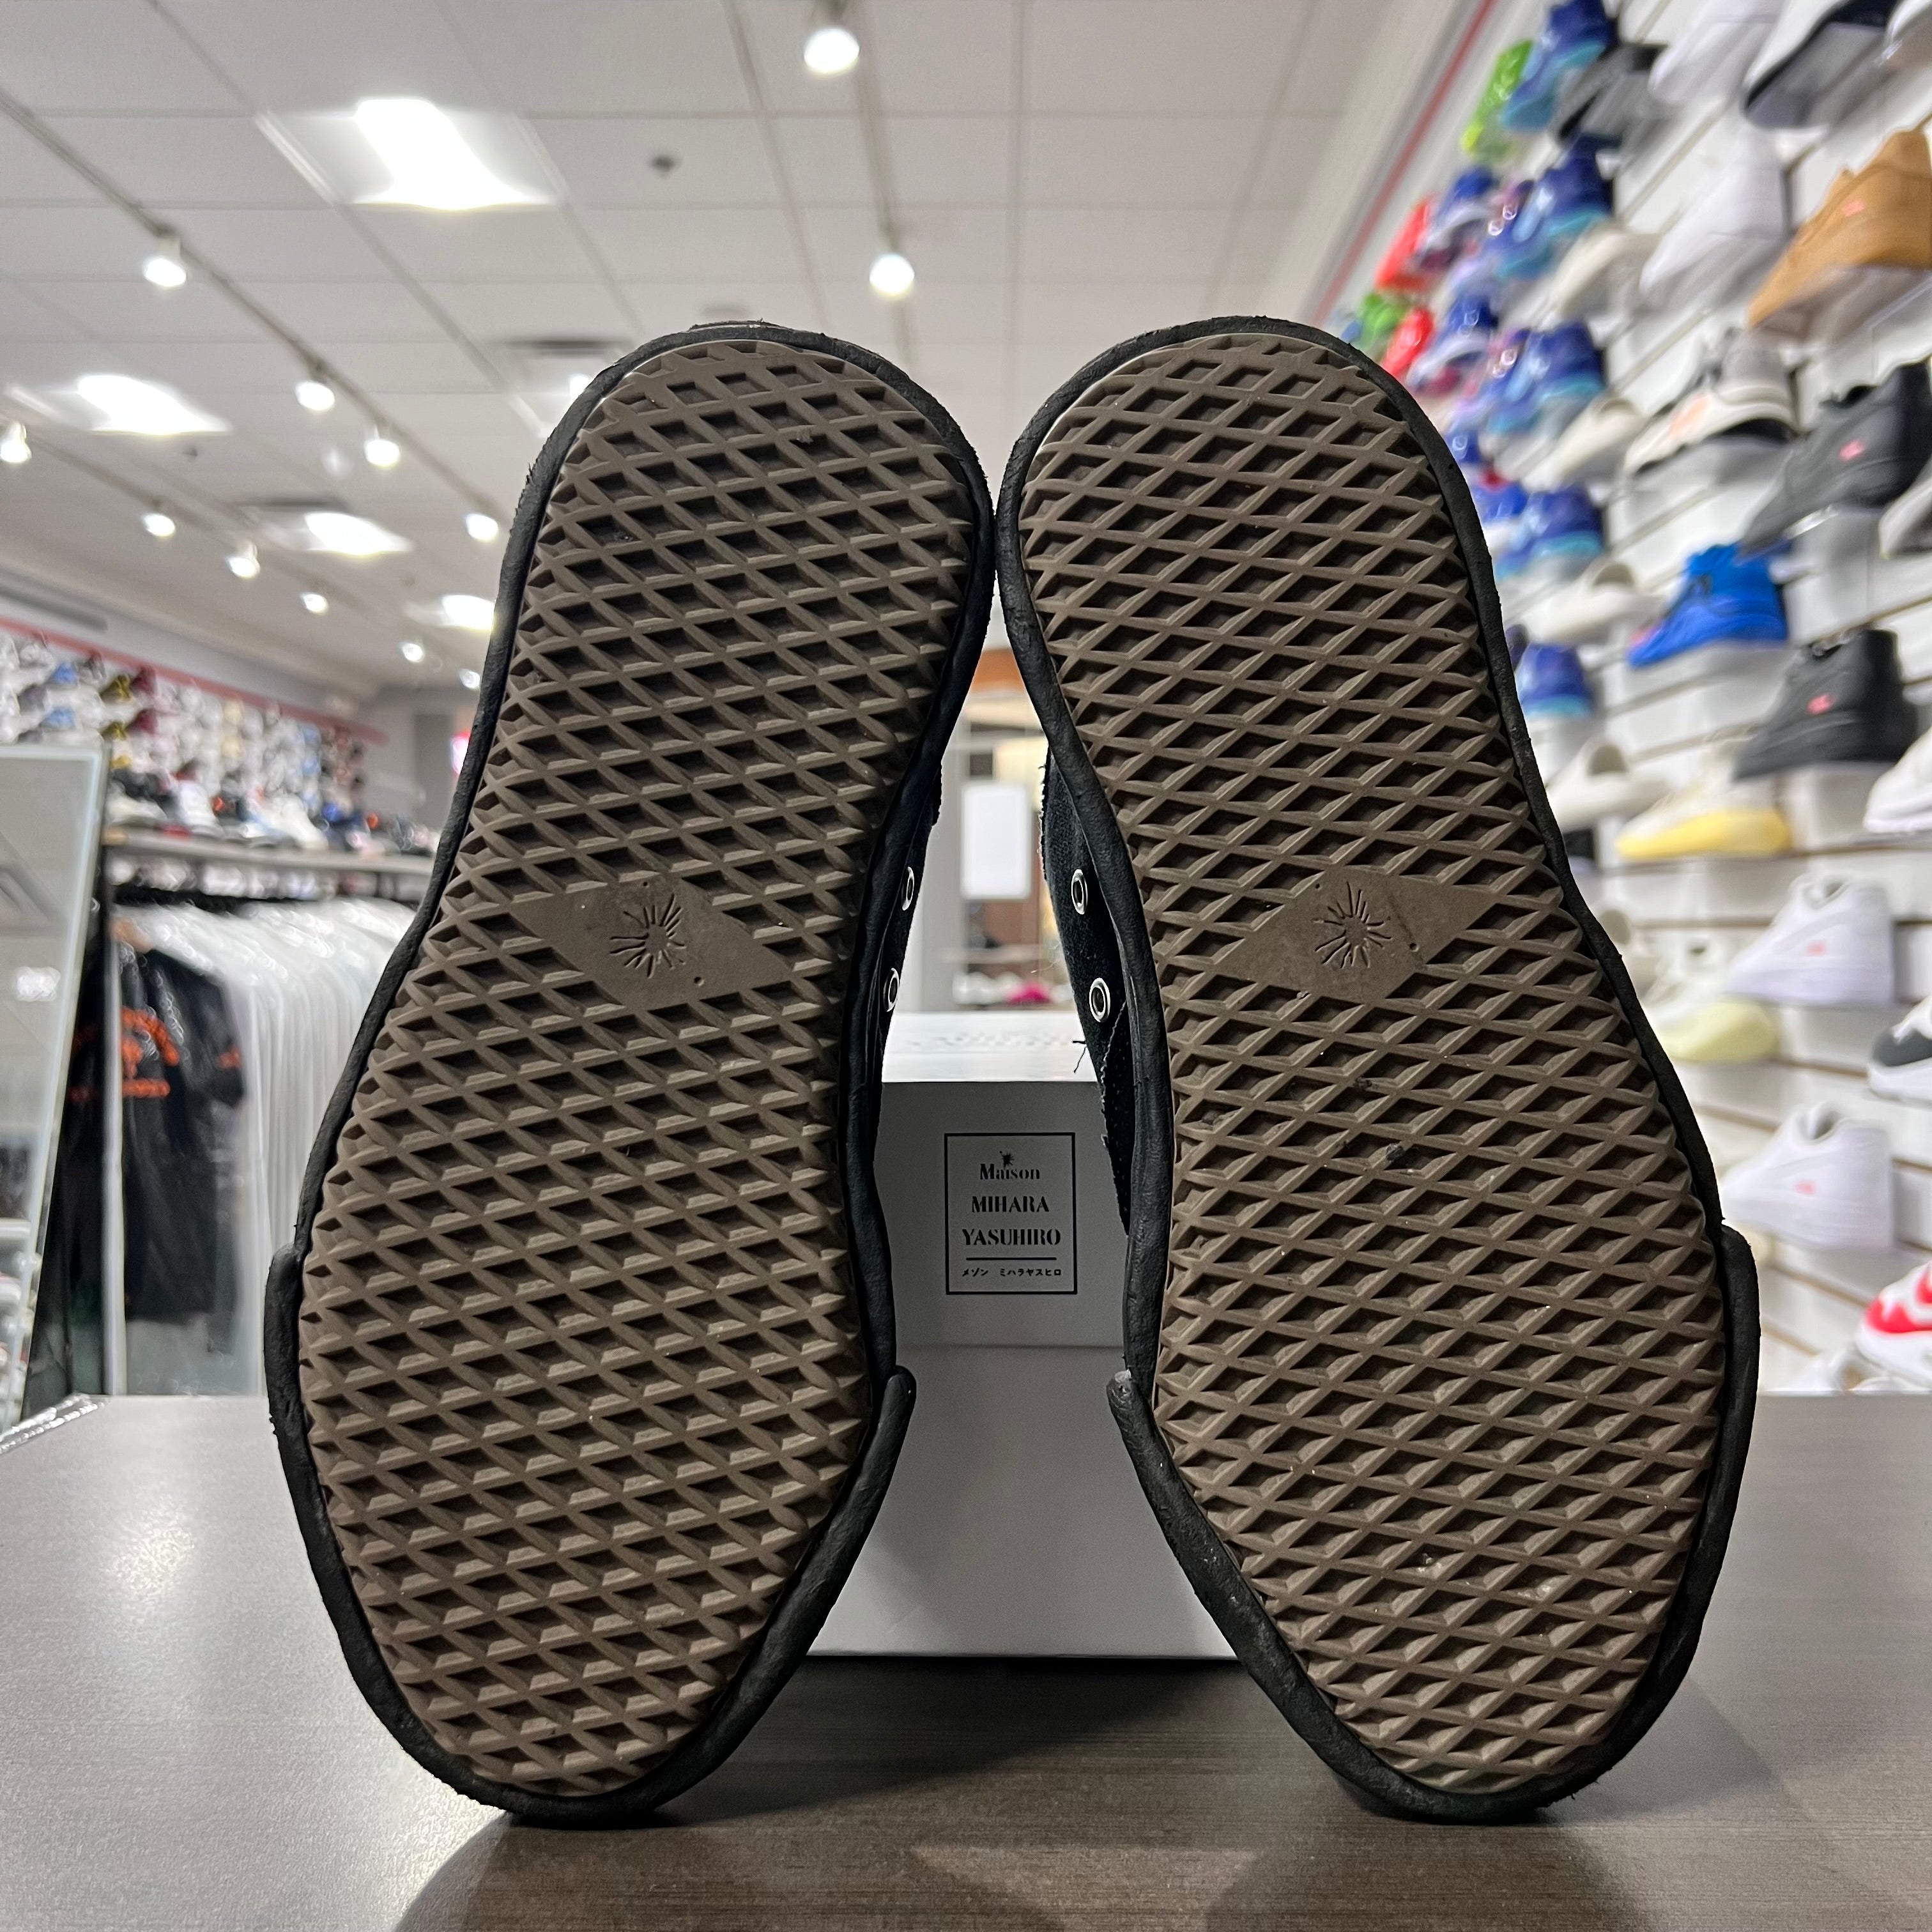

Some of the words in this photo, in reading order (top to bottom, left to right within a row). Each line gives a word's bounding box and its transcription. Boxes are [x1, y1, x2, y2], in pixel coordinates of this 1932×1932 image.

[980, 1163, 1040, 1180] Maison
[972, 1196, 1050, 1213] MIHARA
[962, 1229, 1061, 1245] YASUHIRO
[999, 1268, 1062, 1276] ミハラヤスヒロ
